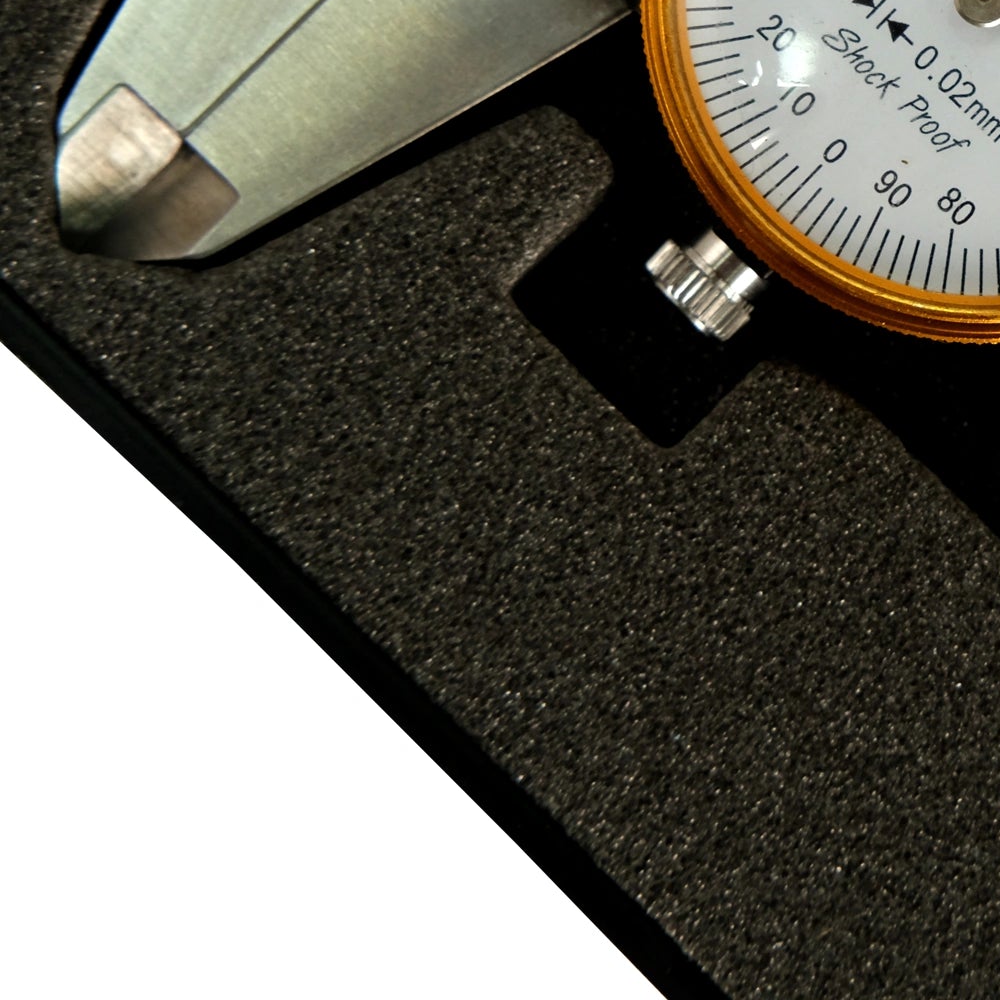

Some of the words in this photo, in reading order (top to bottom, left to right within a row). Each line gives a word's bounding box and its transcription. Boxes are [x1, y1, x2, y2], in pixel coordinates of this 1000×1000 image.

[755, 14, 797, 52] 20
[821, 27, 901, 99] Shock
[897, 94, 972, 153] Proof
[823, 138, 848, 164] 0
[873, 169, 913, 208] 90
[936, 187, 976, 226] 80
